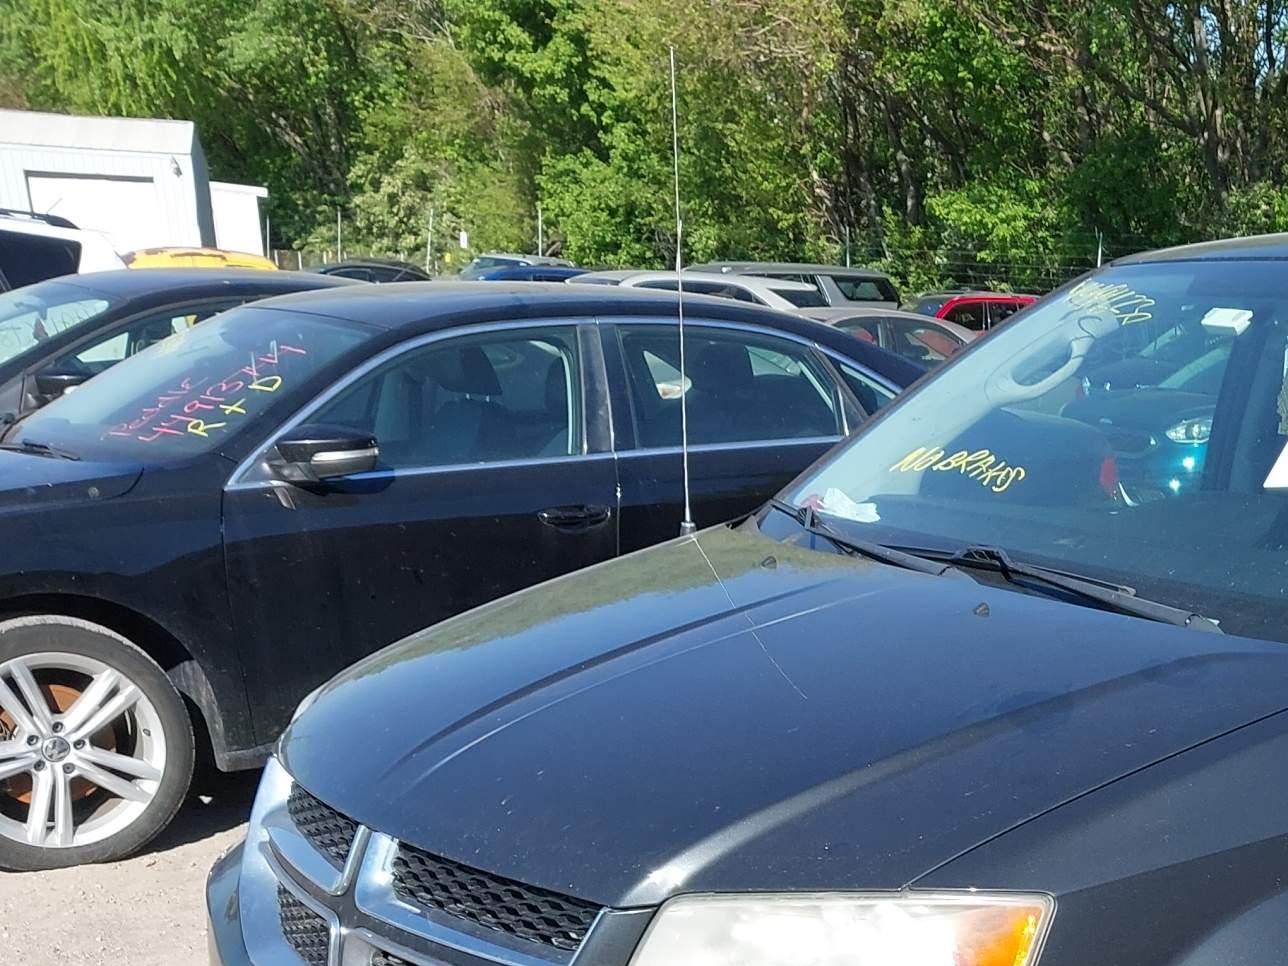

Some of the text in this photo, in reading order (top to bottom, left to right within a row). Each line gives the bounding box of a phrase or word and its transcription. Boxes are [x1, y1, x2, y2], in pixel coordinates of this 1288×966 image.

[188, 420, 227, 437] R
[248, 375, 282, 392] D
[889, 446, 945, 472] NO
